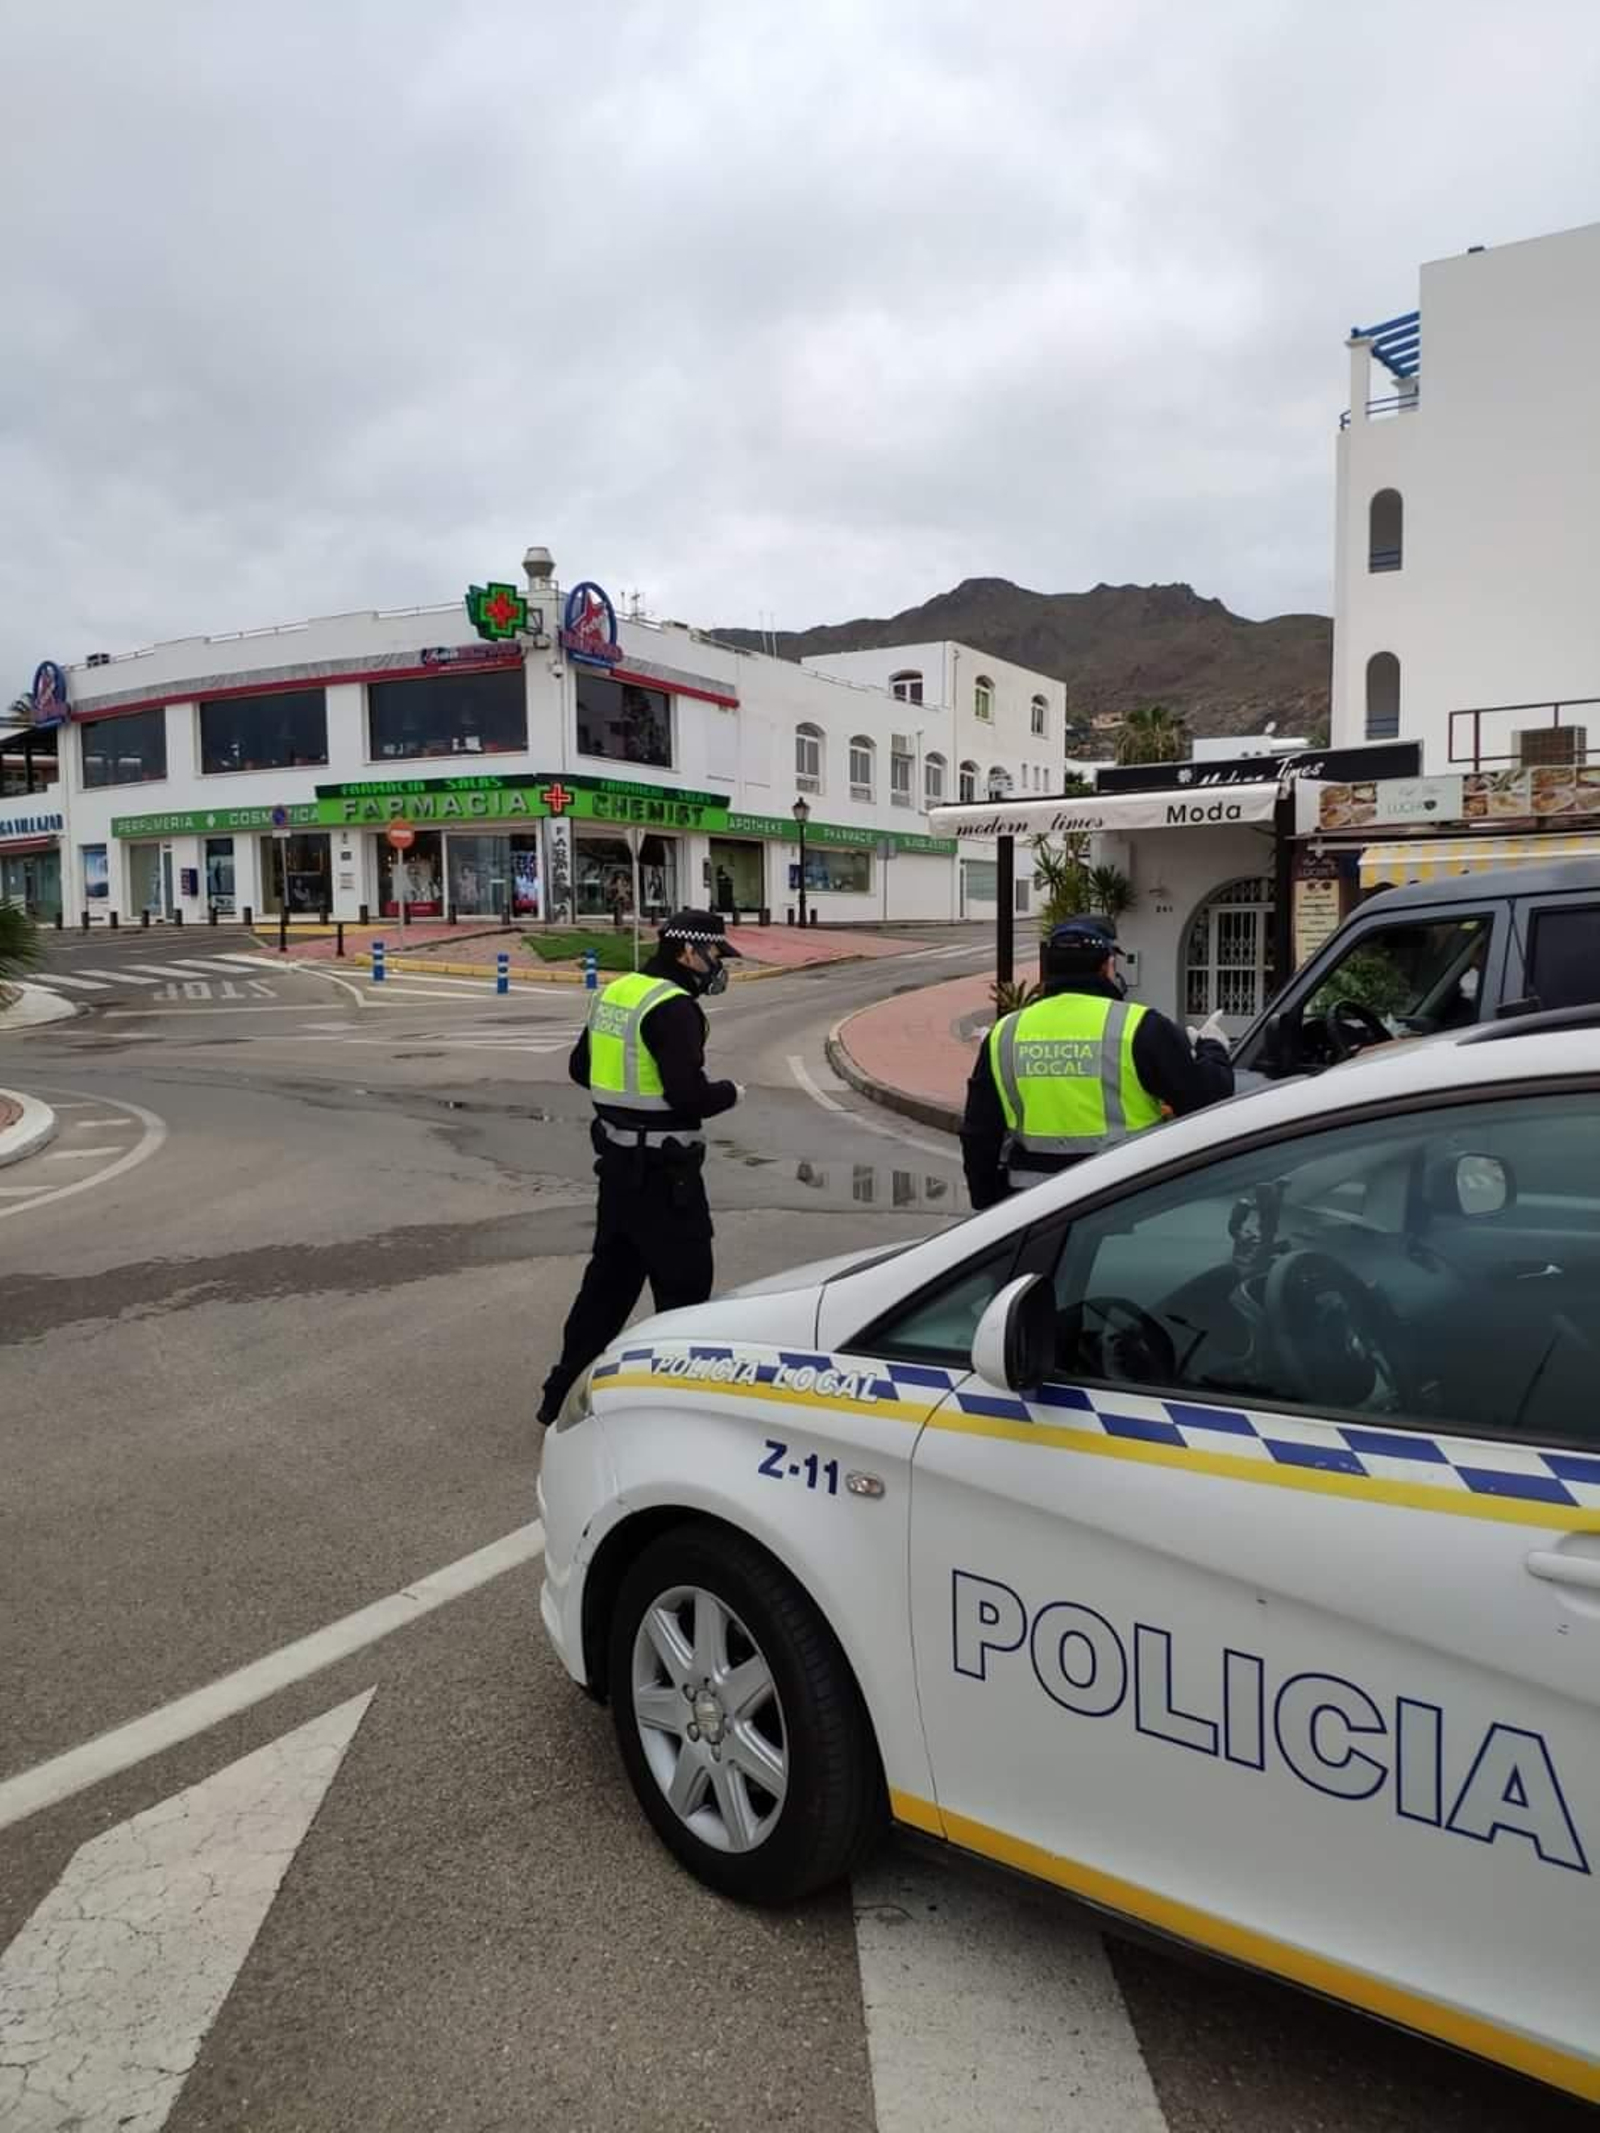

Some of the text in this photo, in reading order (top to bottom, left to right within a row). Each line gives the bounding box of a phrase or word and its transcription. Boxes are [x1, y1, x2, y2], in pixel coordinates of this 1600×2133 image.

[343, 791, 530, 821] FARMACIA
[592, 792, 705, 826] CHEMIST
[1166, 801, 1242, 825] Moda
[728, 817, 783, 834] APOTHEKE
[957, 812, 1105, 836] modern times
[1018, 1043, 1094, 1060] POLICIA
[1025, 1060, 1087, 1076] LOCAL
[652, 1356, 879, 1404] POLICIA LOCAL
[757, 1439, 839, 1496] Z-11
[951, 1568, 1593, 1876] POLICIA
